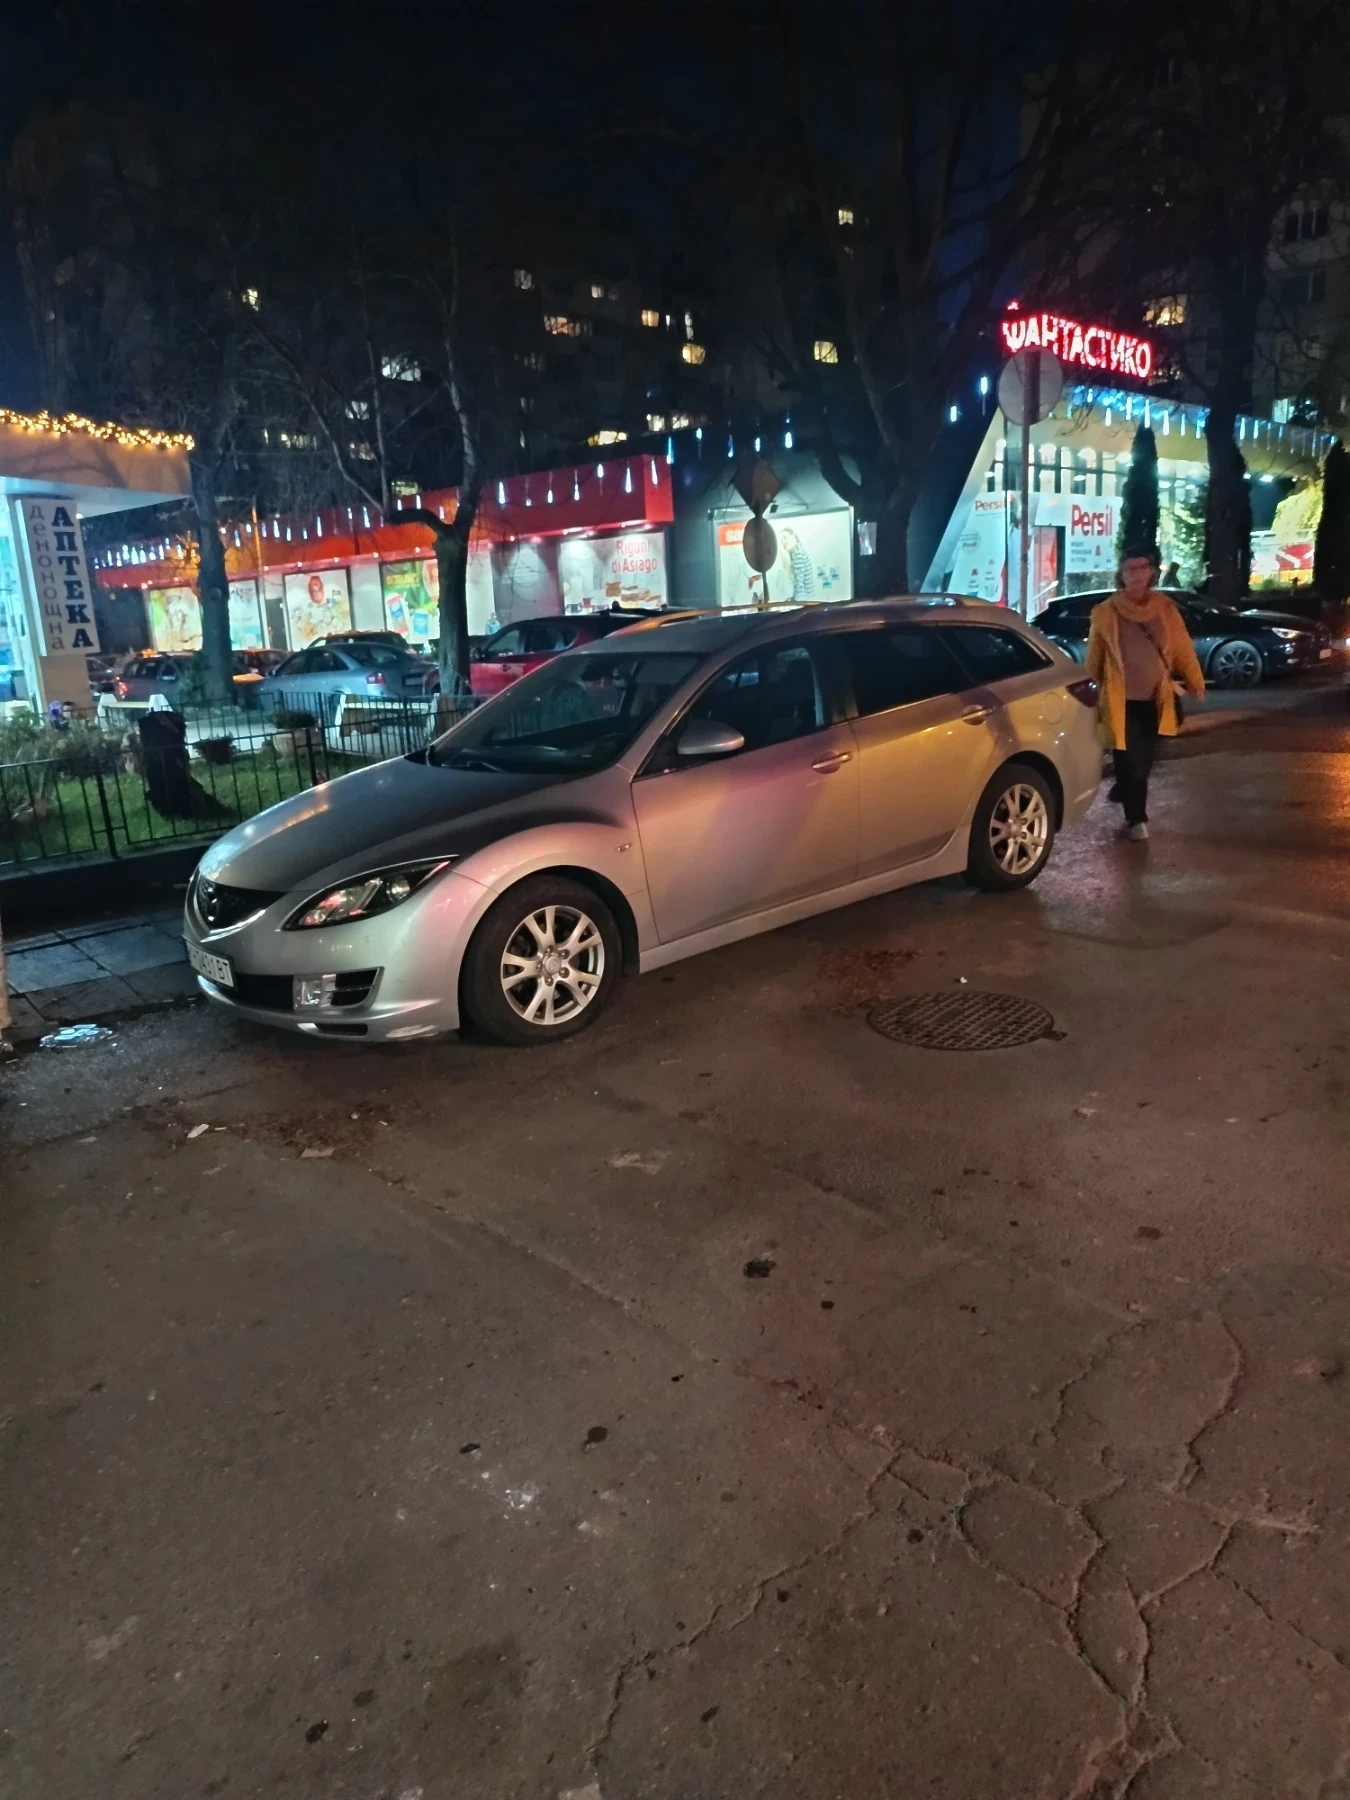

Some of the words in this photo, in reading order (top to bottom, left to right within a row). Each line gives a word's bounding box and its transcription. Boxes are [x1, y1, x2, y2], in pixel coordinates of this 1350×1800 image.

[1002, 302, 1151, 378] ФАНТАСТИКО
[1071, 503, 1113, 537] Persil
[616, 540, 651, 558] Rigoni
[622, 557, 658, 574] Asiago
[52, 506, 94, 648] АПТЕКА
